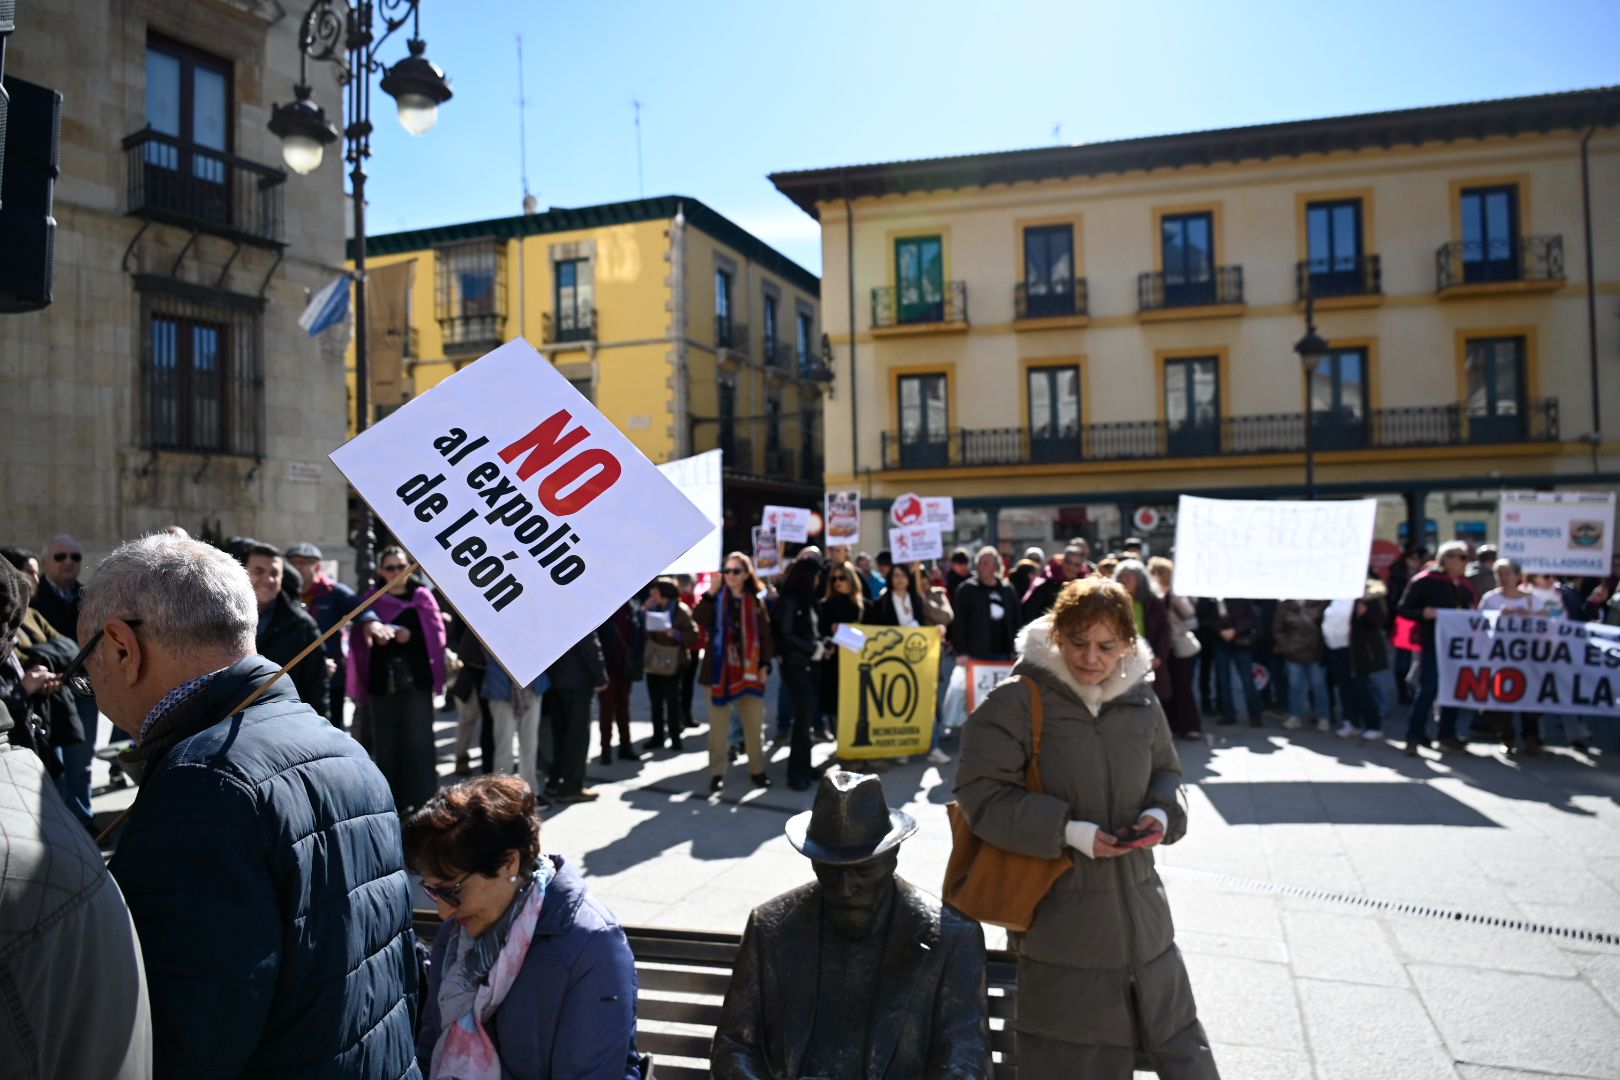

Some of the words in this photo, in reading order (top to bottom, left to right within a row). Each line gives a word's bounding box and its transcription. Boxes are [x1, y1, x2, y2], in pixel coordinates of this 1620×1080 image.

[497, 408, 622, 517] NO
[433, 427, 490, 467] al
[466, 461, 586, 586] expolio
[396, 473, 449, 523] de
[434, 508, 524, 613] León
[1504, 527, 1562, 539] QUEREMOS
[1468, 617, 1547, 634] VALLES
[1449, 637, 1480, 660] EL
[1488, 638, 1572, 665] AGUA
[1454, 666, 1527, 704] NO
[1537, 671, 1560, 704] A
